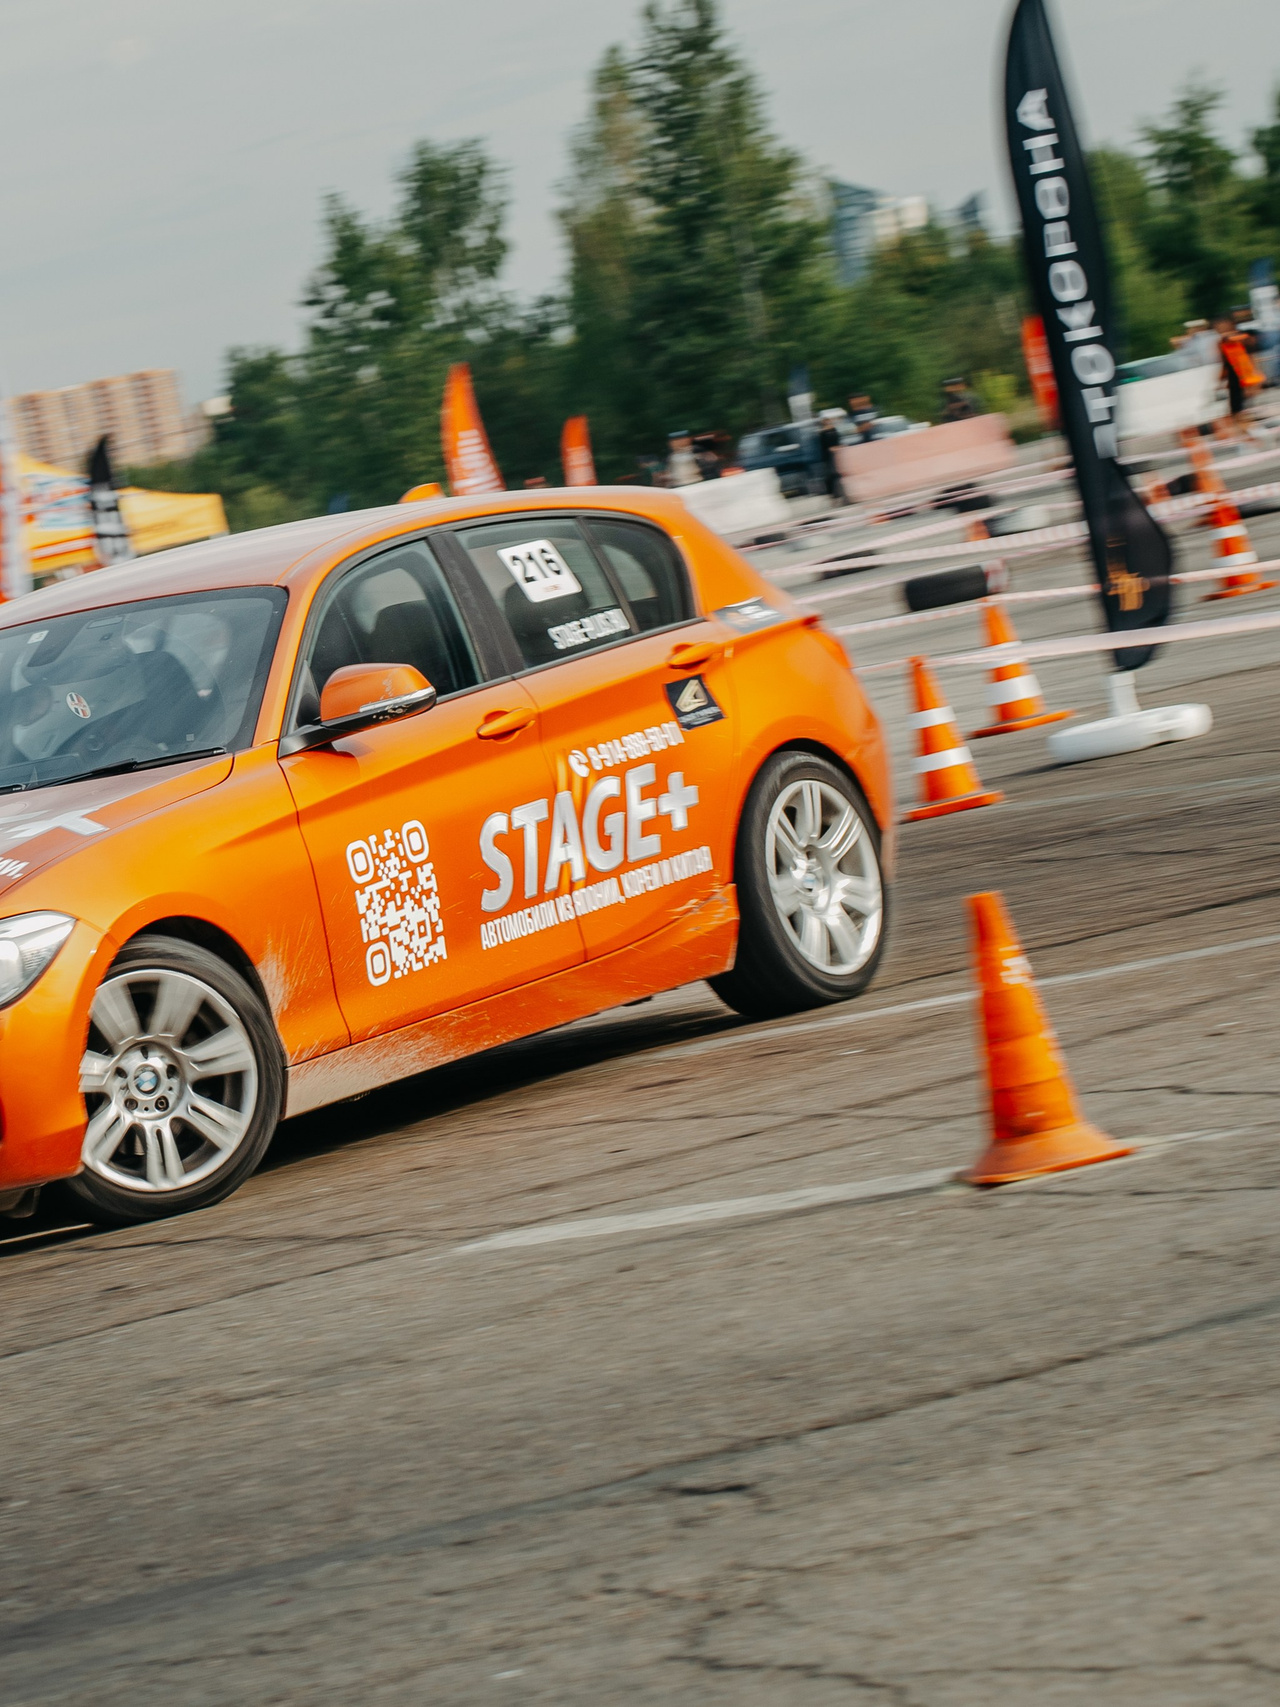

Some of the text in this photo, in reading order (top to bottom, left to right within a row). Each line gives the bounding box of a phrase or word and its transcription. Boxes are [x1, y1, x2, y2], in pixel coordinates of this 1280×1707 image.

[509, 547, 562, 583] 216
[480, 763, 699, 913] STAGE+
[481, 900, 560, 950] АВТОМОБИЛИ
[555, 893, 576, 923] ИЗ
